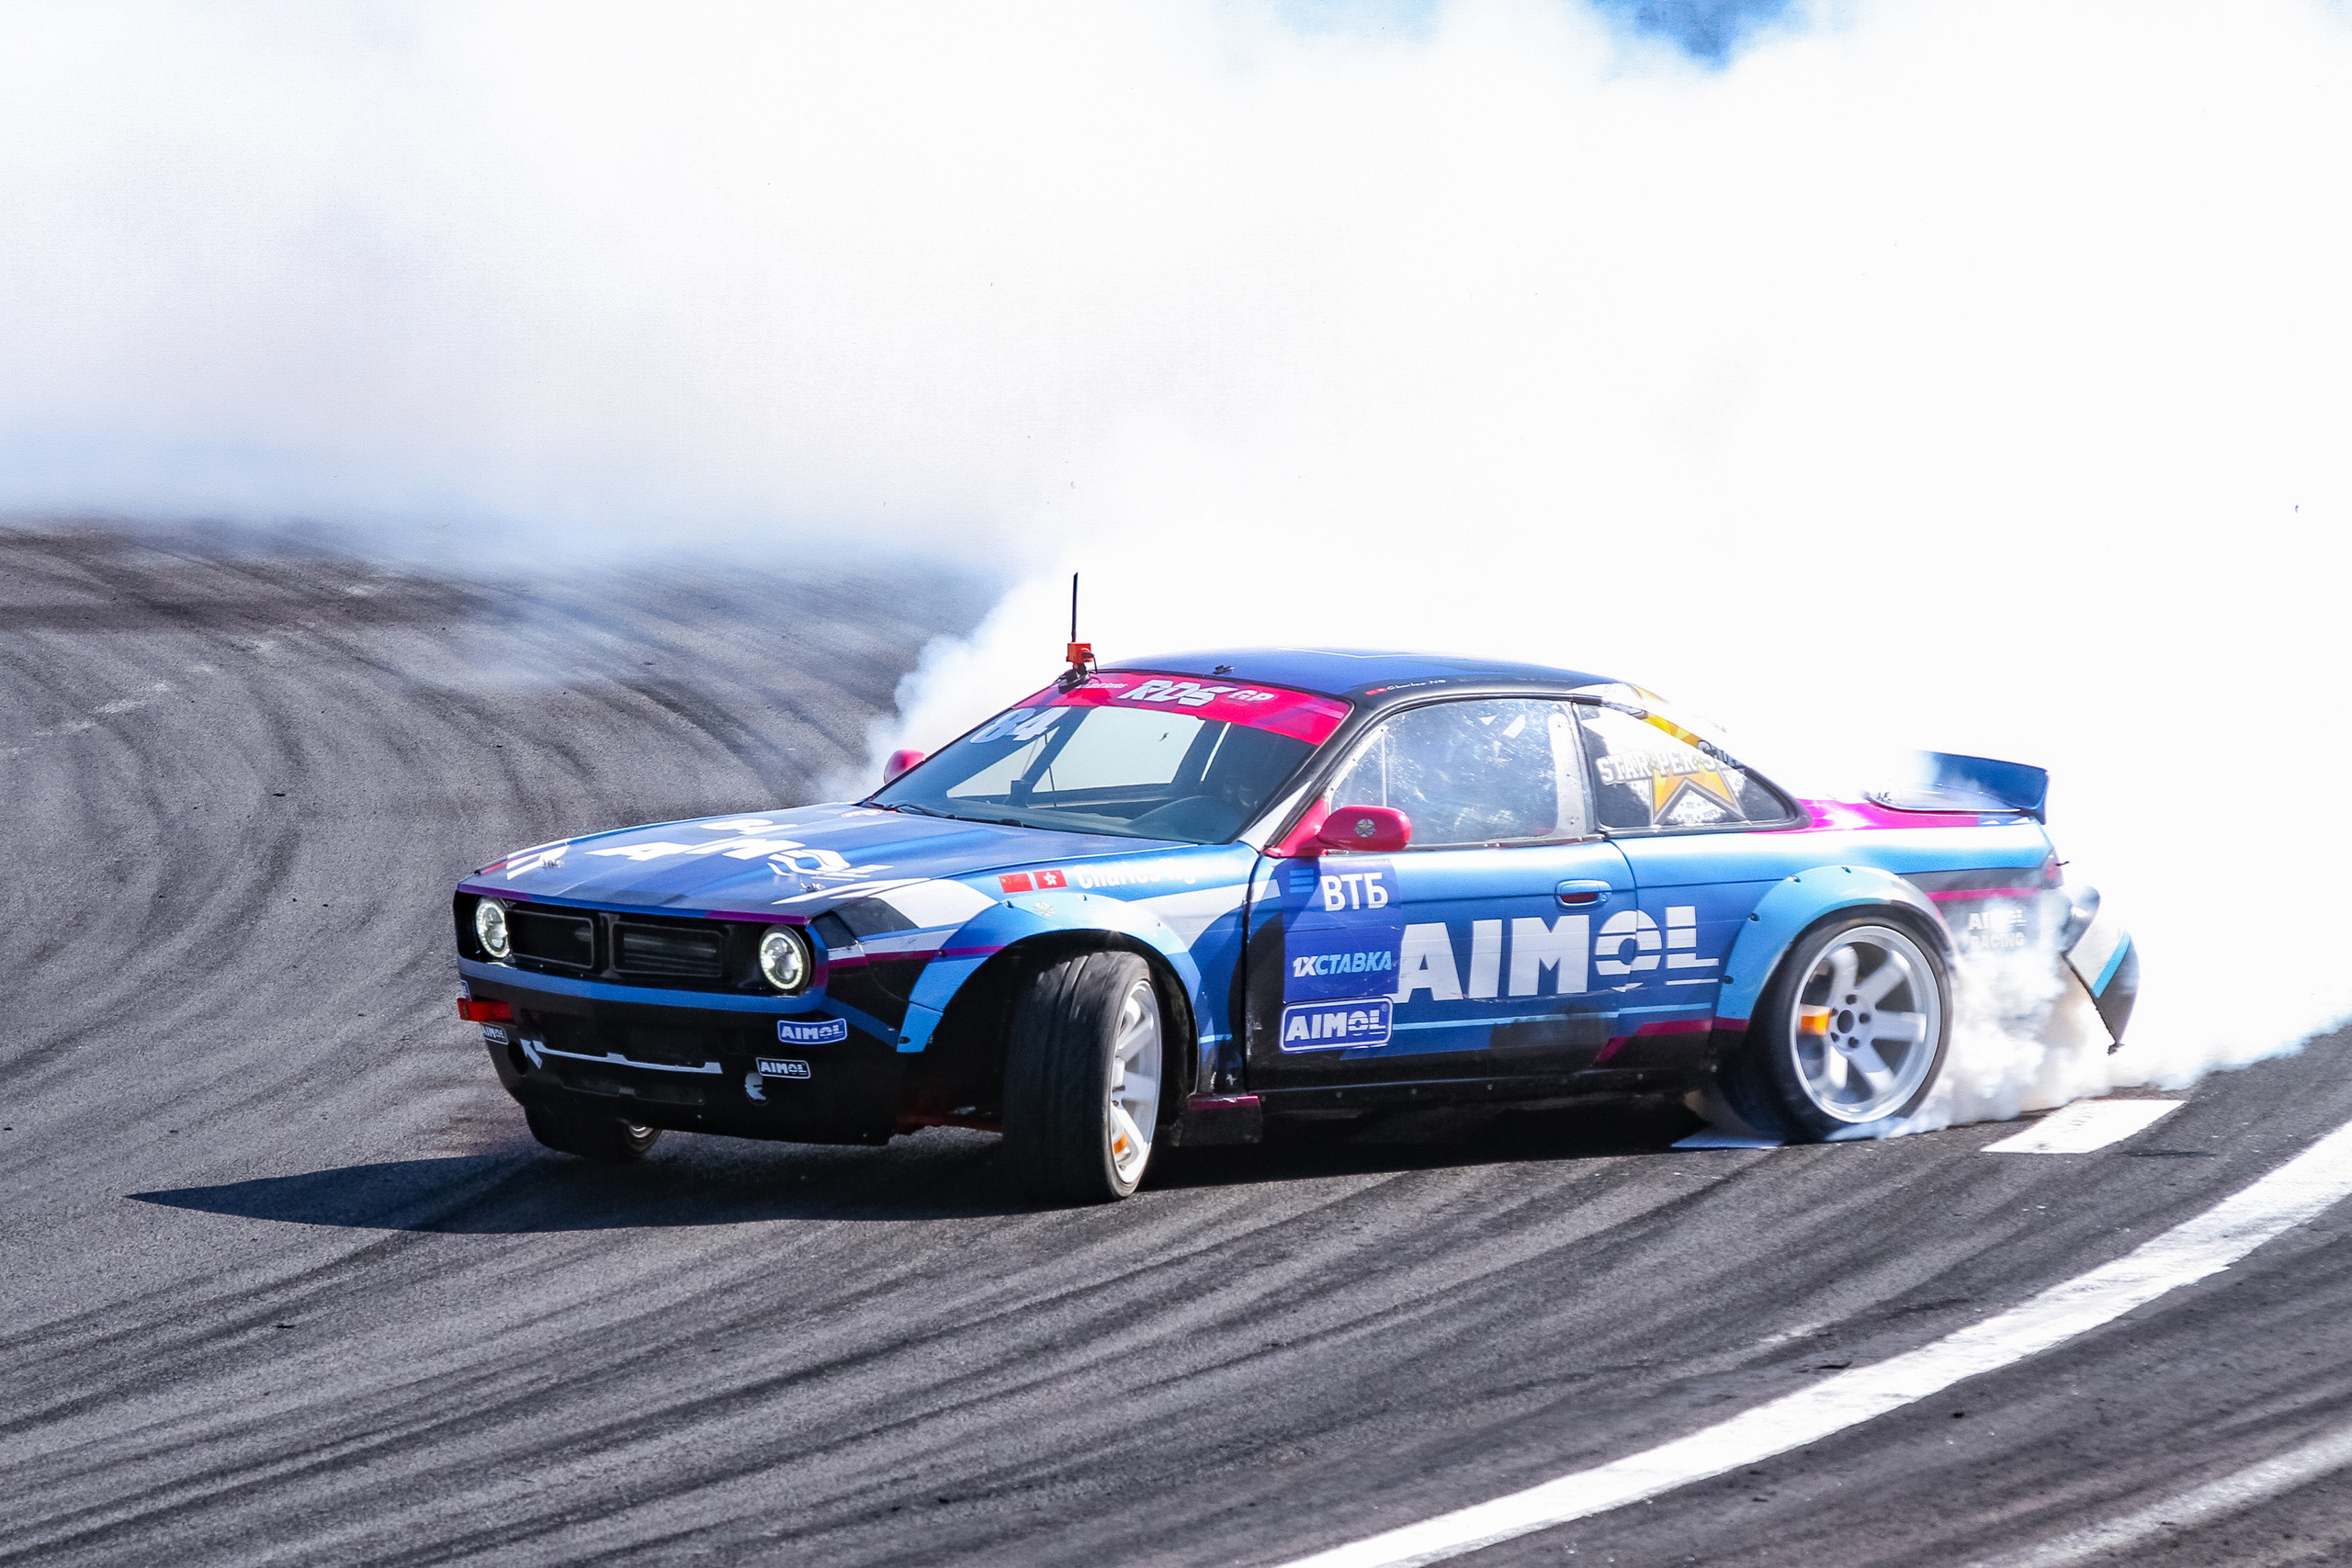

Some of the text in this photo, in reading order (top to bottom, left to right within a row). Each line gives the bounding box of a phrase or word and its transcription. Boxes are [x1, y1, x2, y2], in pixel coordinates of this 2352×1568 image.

[1117, 679, 1274, 706] RDS GP
[969, 706, 1071, 744] 84
[1596, 750, 1652, 784] STAR
[1319, 872, 1389, 912] ВТБ
[1391, 906, 1720, 1004] AIMOL
[781, 1024, 844, 1040] AIMOL
[1285, 1010, 1386, 1042] AIMOL
[760, 1061, 808, 1076] AIMOL
